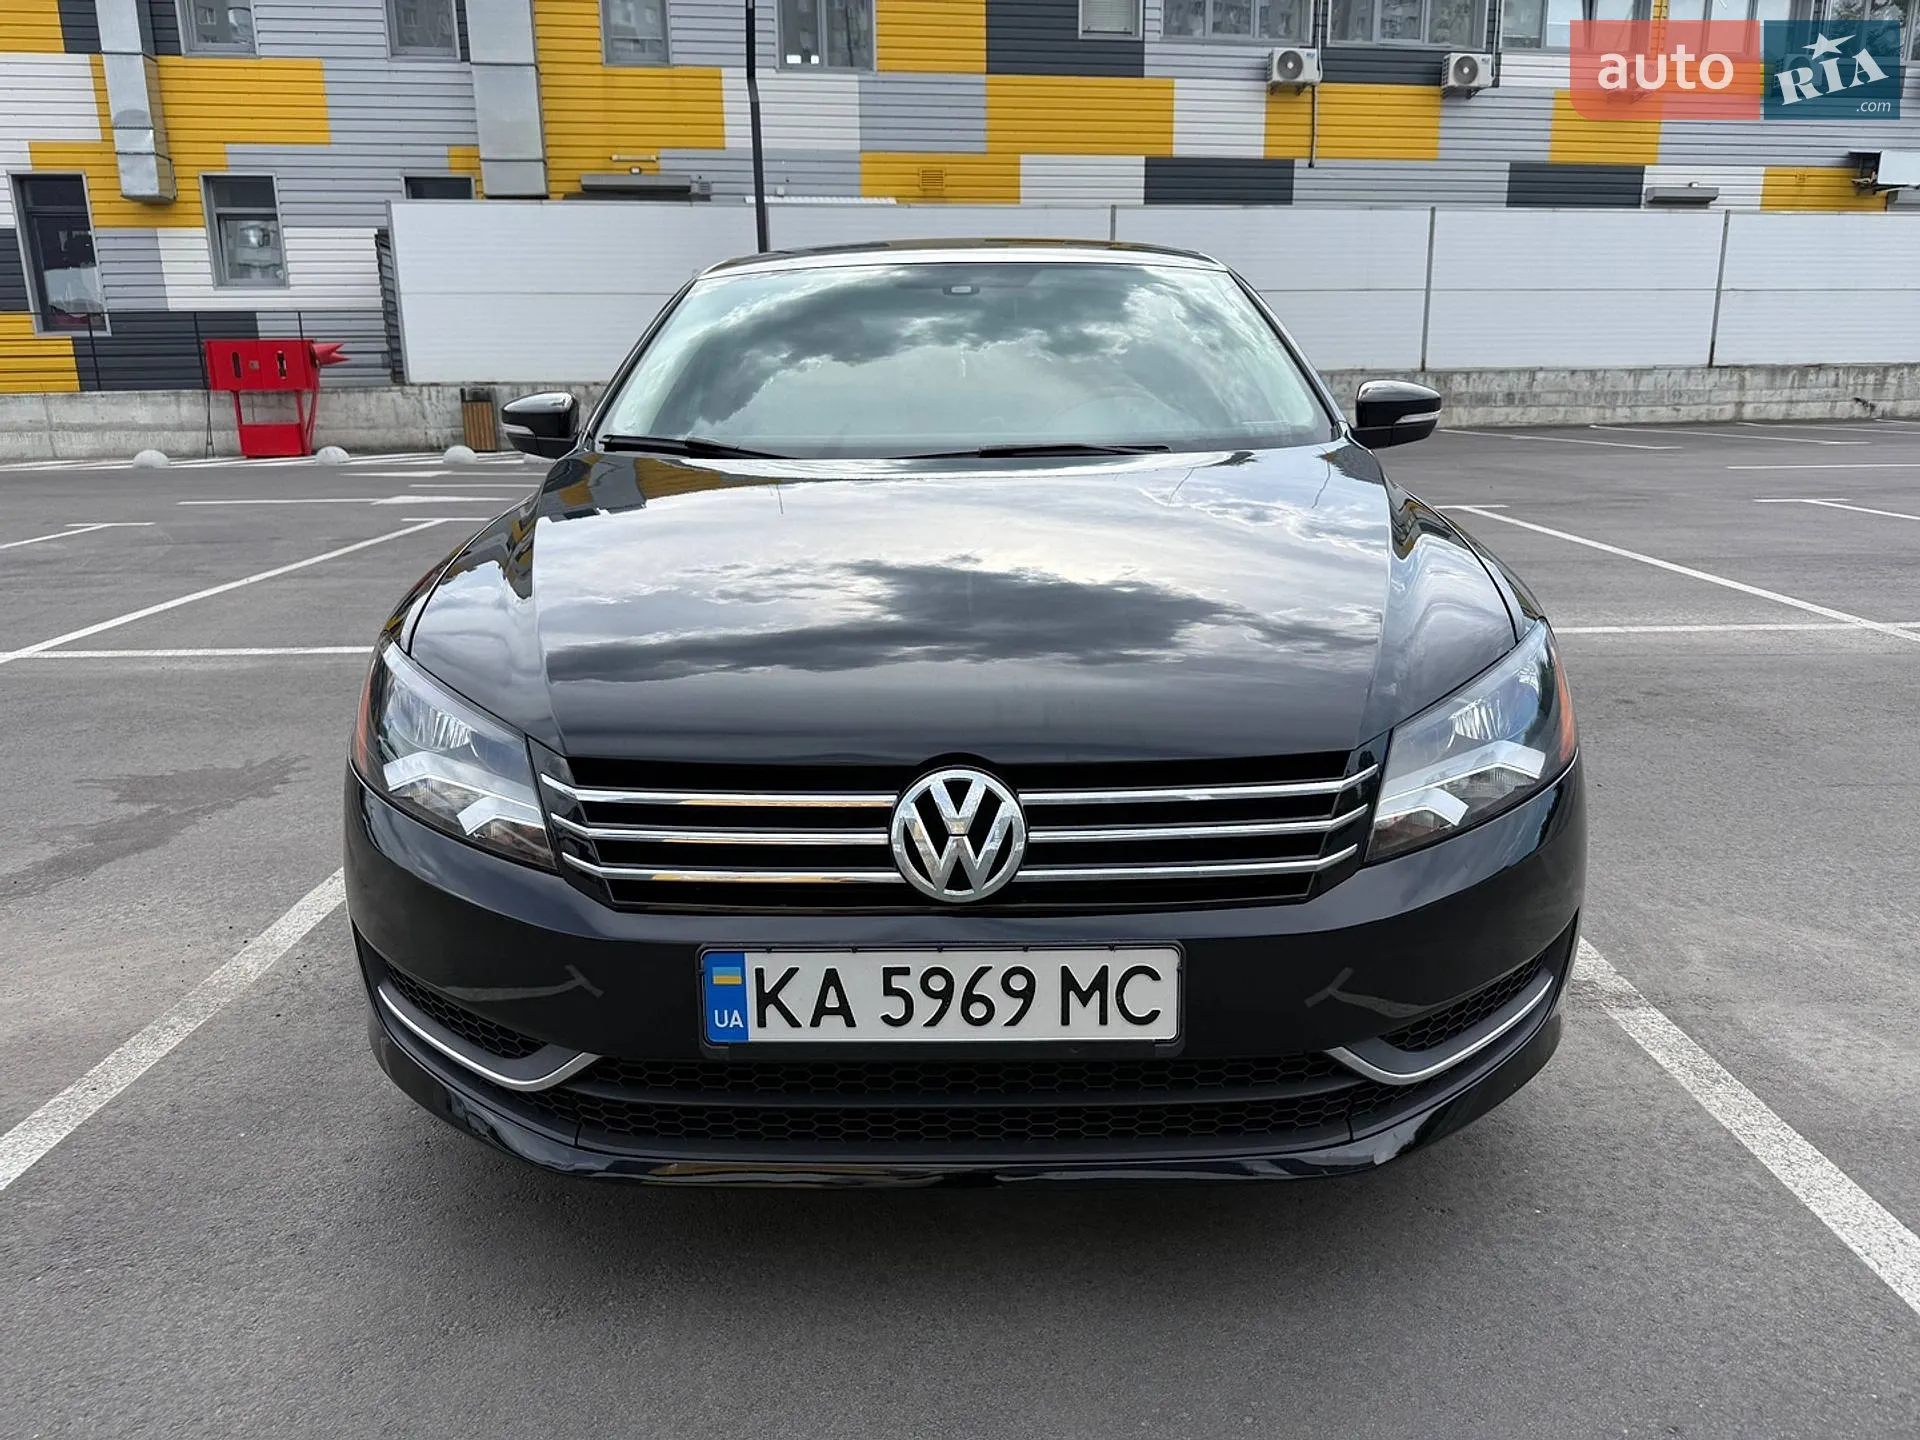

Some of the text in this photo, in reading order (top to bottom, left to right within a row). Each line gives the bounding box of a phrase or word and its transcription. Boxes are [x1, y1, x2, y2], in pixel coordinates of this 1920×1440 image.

[755, 964, 1162, 1028] KA 5969 MC
[714, 1009, 744, 1028] UA
